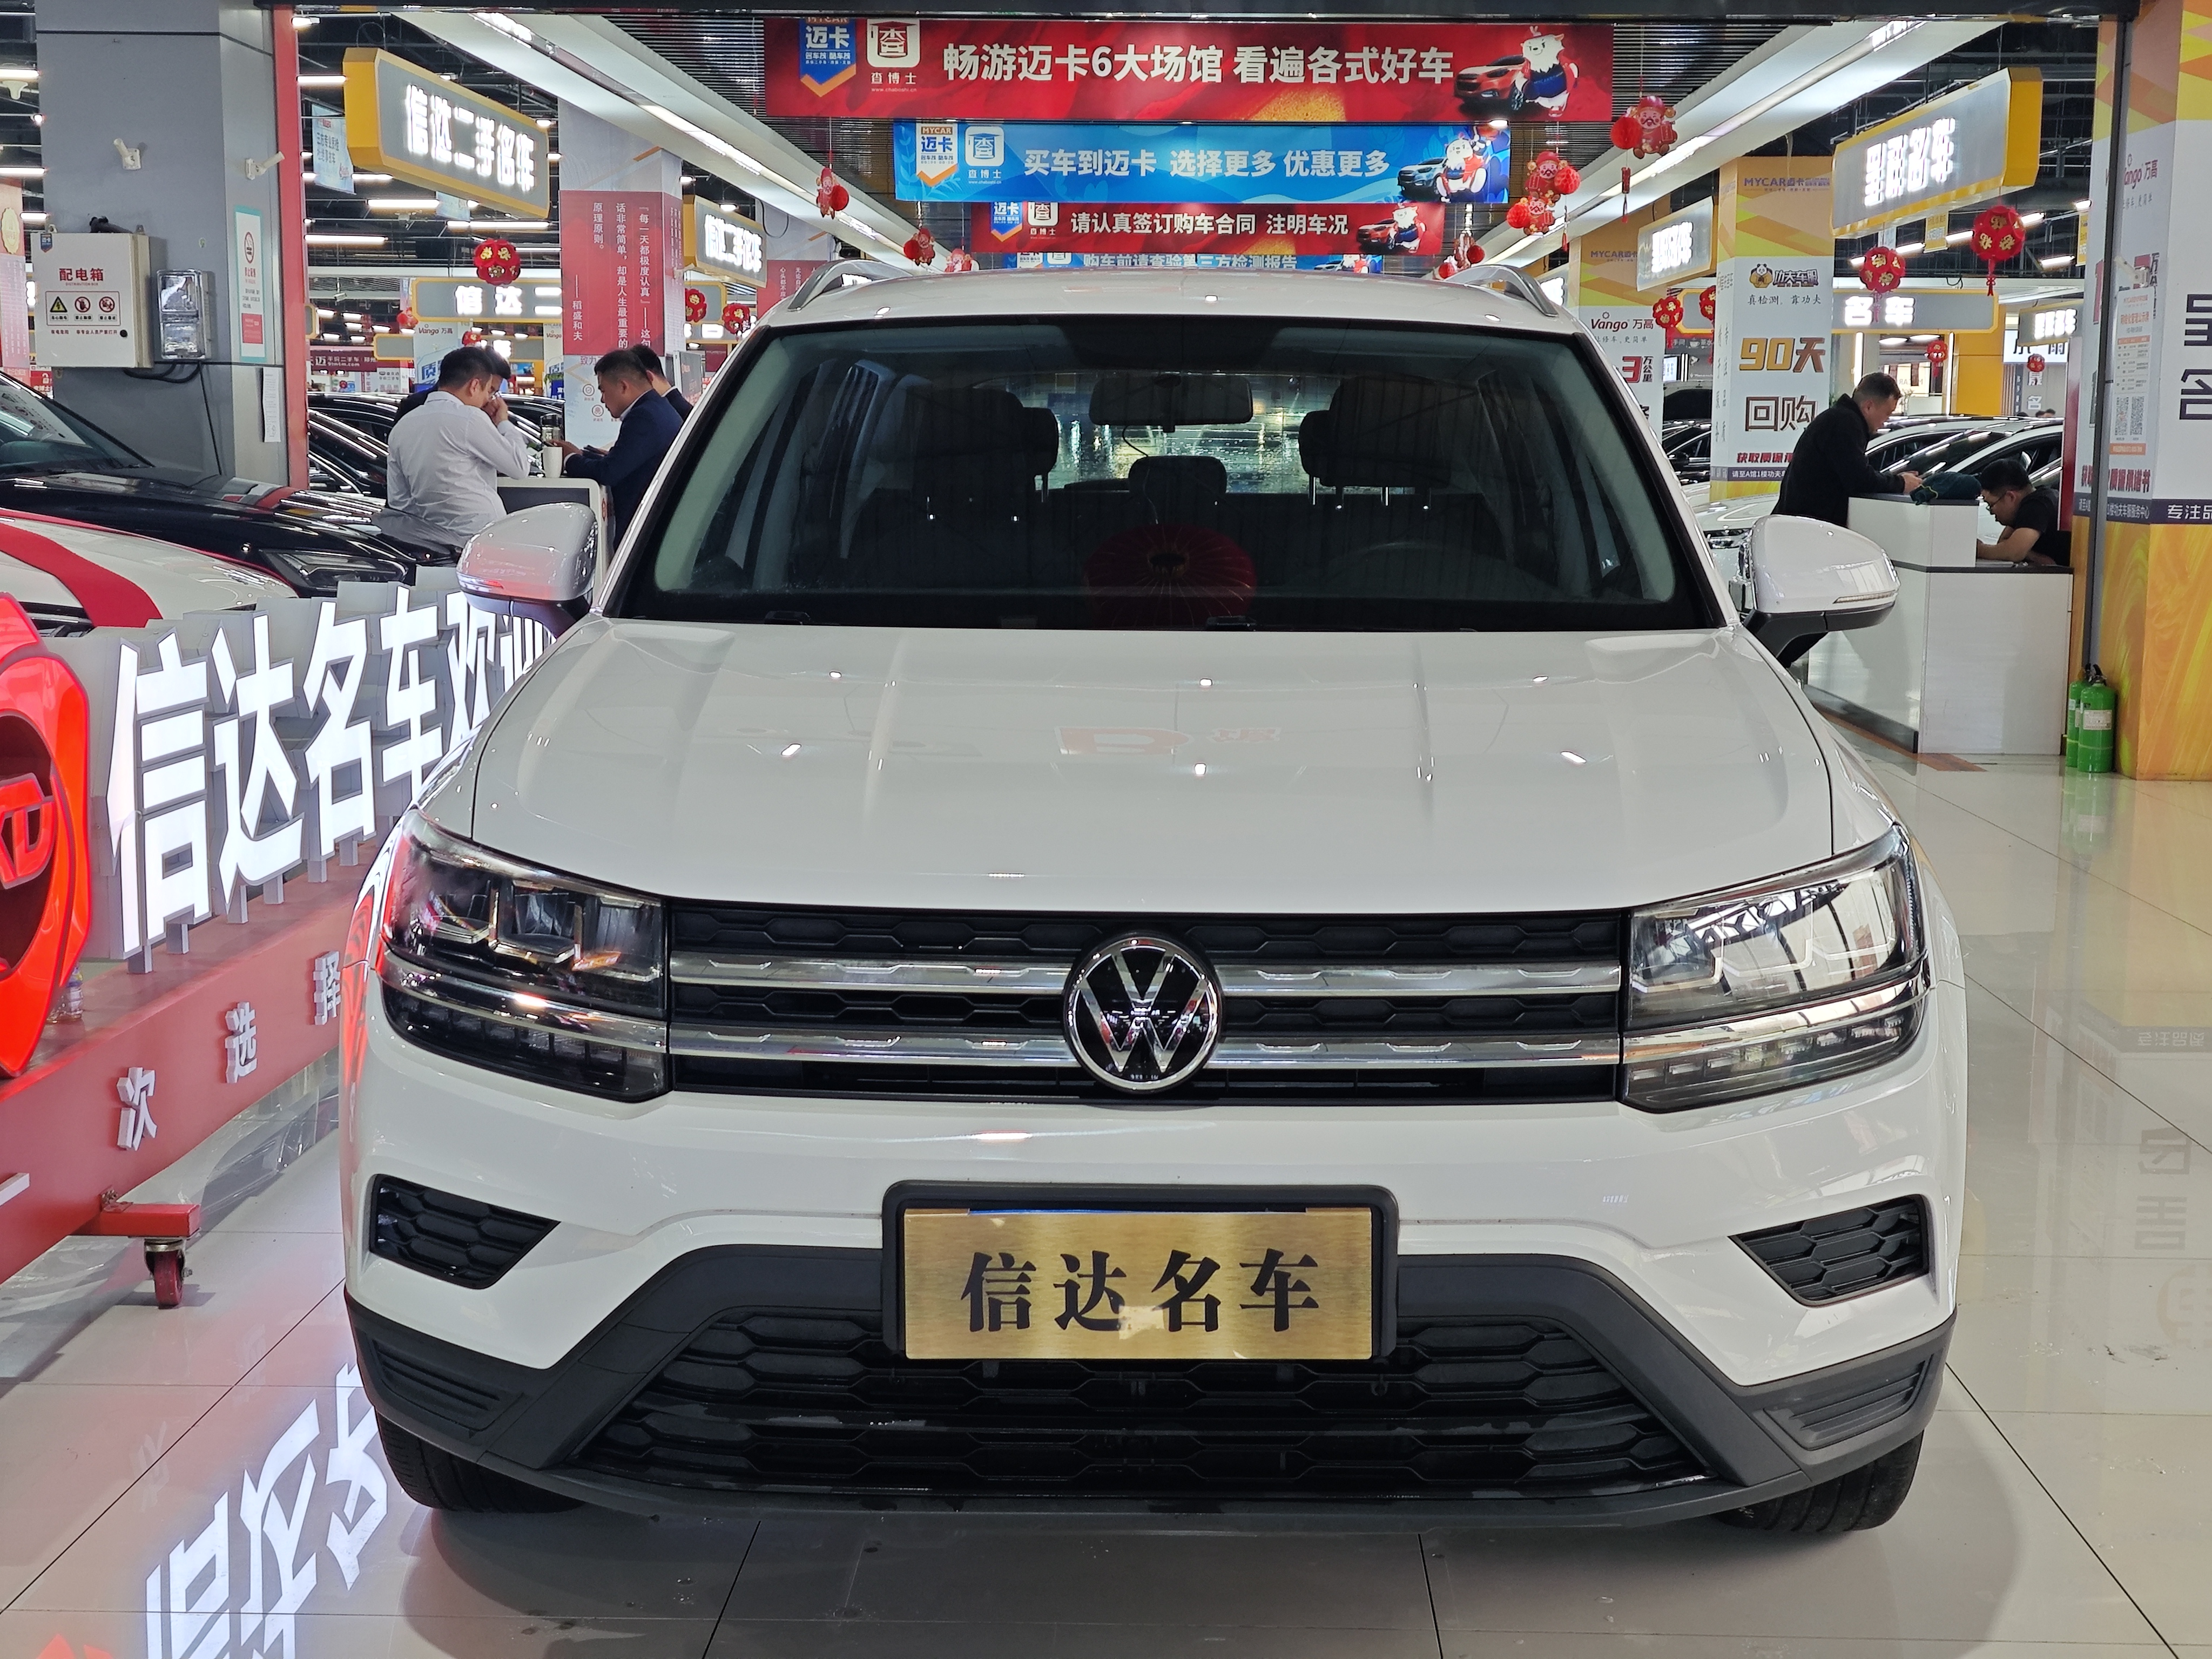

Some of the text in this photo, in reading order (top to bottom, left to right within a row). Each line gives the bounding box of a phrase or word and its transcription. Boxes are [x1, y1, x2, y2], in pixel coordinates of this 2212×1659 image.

[805, 26, 850, 49] 迈卡
[942, 43, 1454, 84] 畅游迈卡6大场馆 看遍各式好车
[871, 72, 917, 85] 查博士
[404, 84, 536, 192] 信达二手名车
[921, 136, 953, 153] 迈卡
[968, 169, 1002, 179] 查博士
[1024, 149, 1390, 178] 买车到迈卡 选择更多 优惠更多
[994, 201, 1020, 215] 迈卡
[1071, 212, 1350, 234] 请认真签订购车合同 注明车况
[59, 268, 103, 281] 配电箱
[455, 285, 563, 315] 信达二
[1845, 295, 1914, 327] 名车
[1590, 319, 1654, 332] Vango 万高
[1738, 337, 1826, 373] 90天
[1622, 356, 1654, 383] 3 万公里
[1745, 395, 1818, 431] 回购
[961, 1249, 1319, 1333] 信达名车
